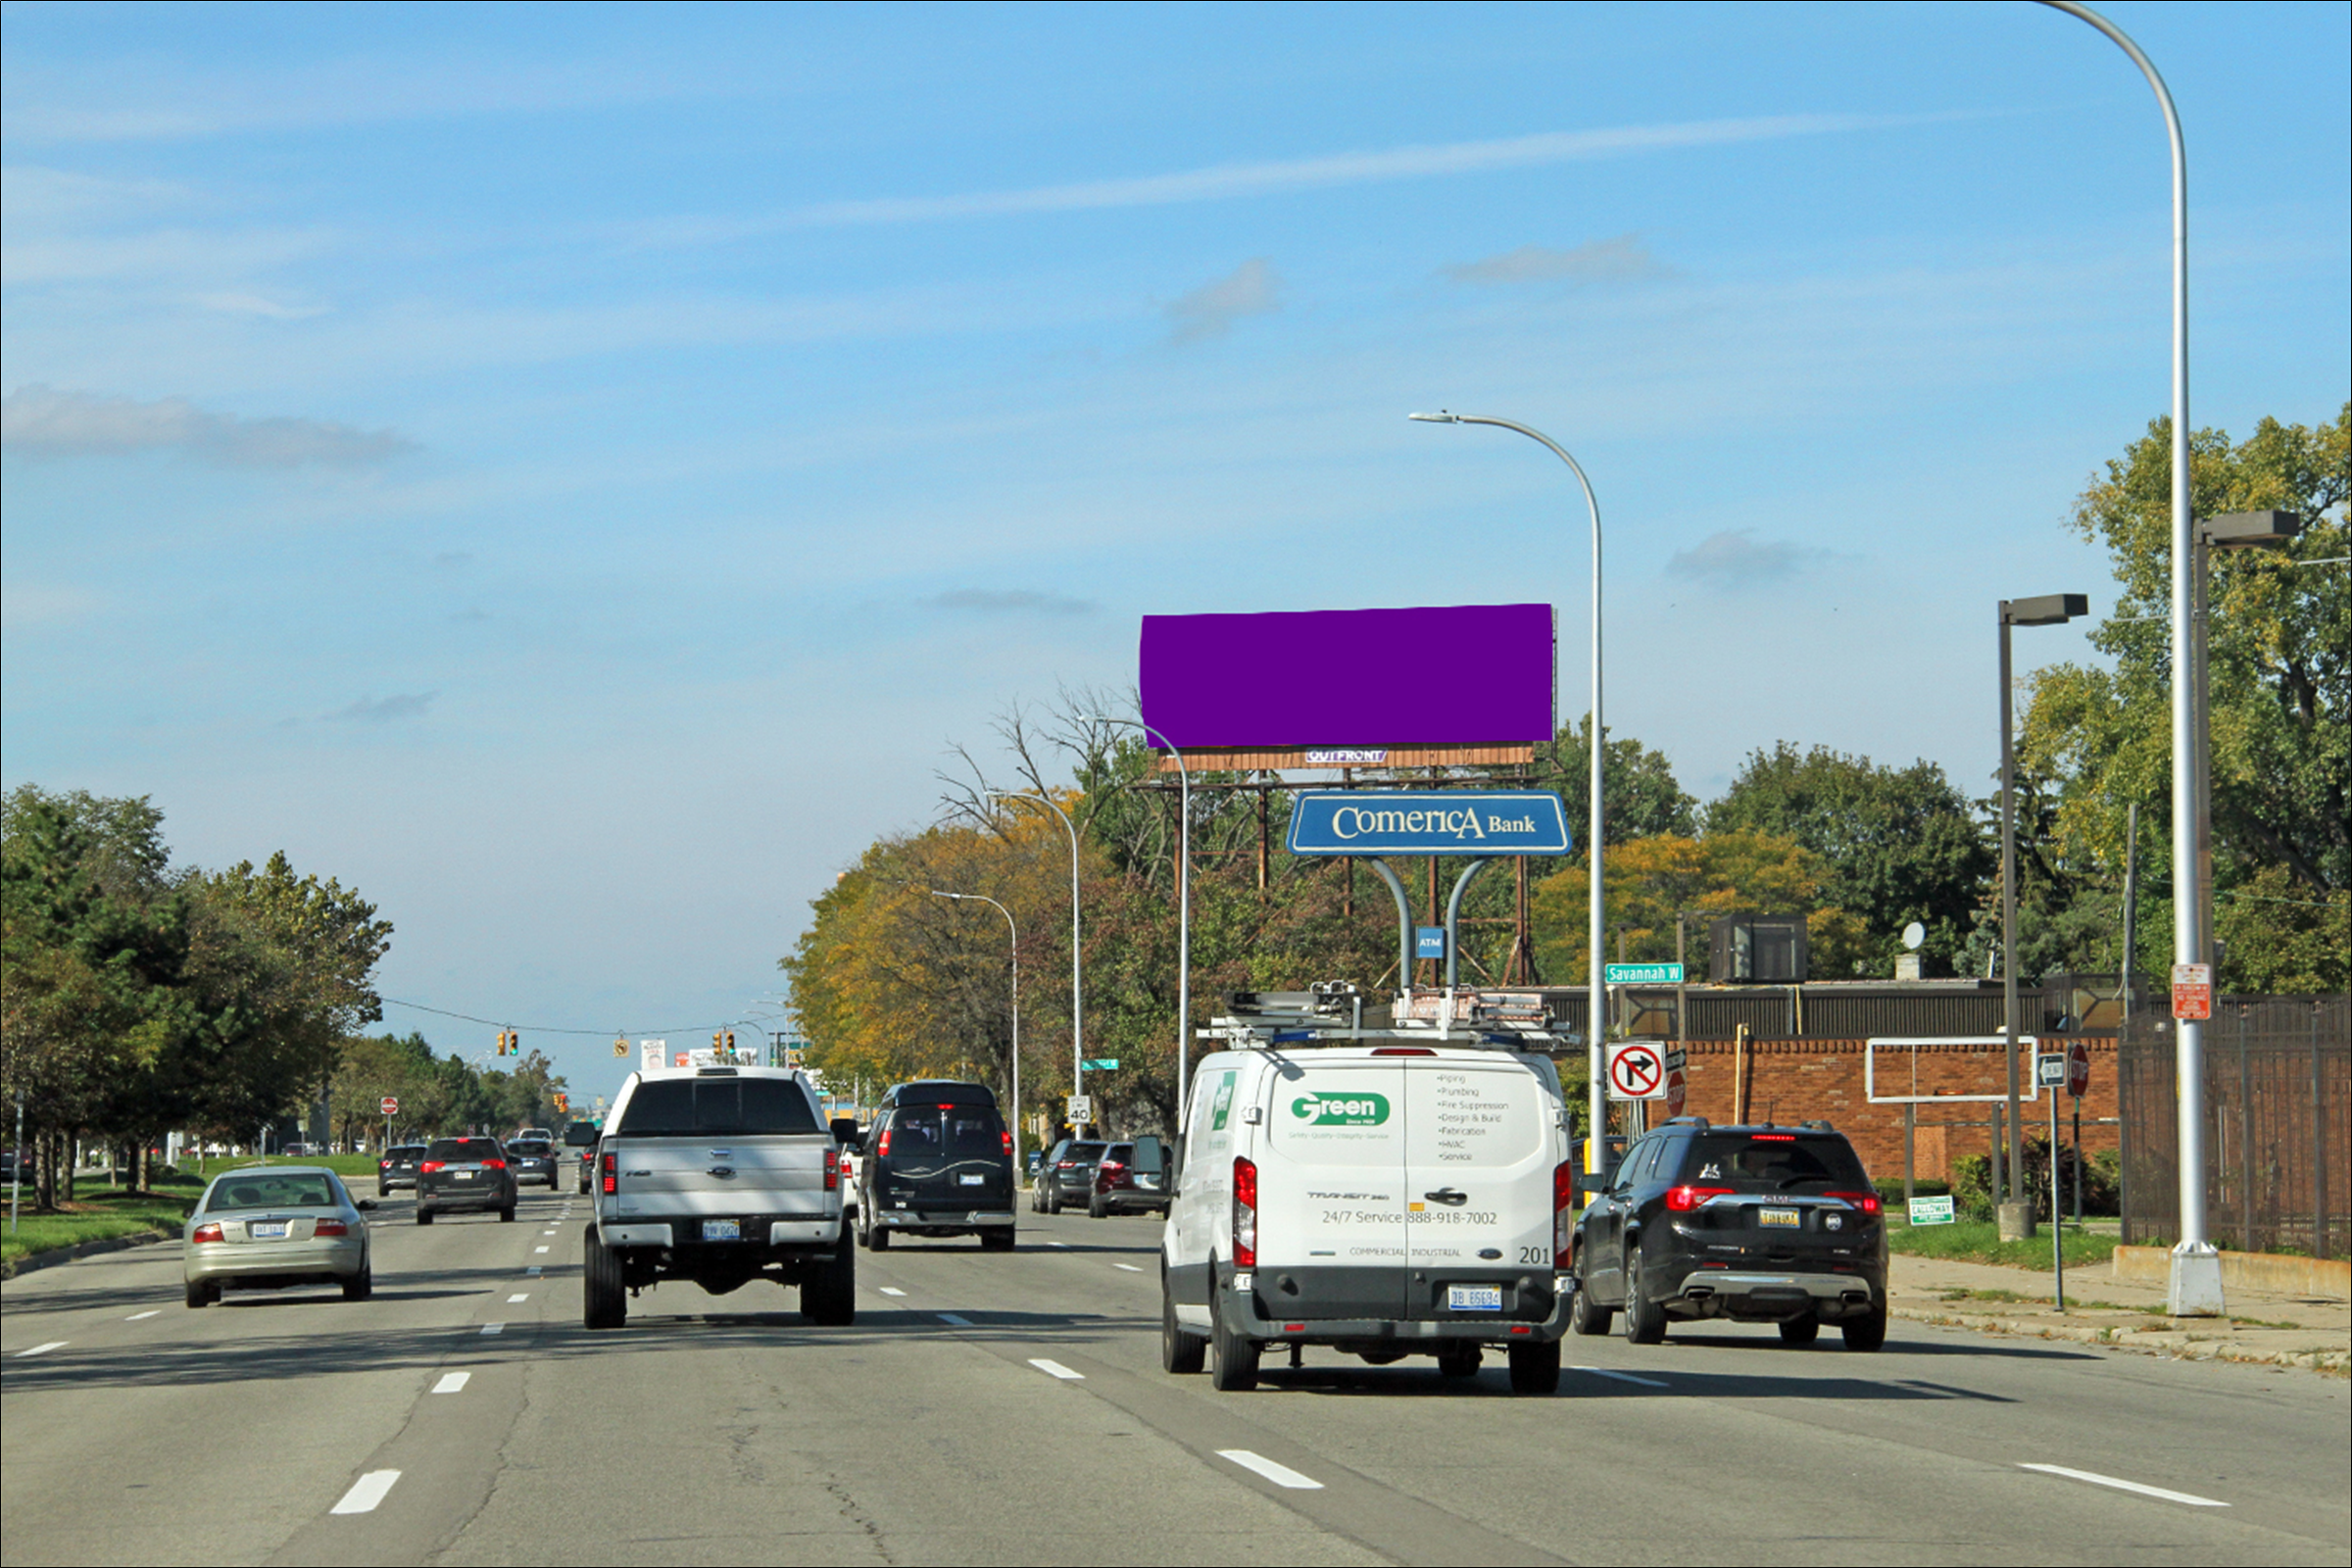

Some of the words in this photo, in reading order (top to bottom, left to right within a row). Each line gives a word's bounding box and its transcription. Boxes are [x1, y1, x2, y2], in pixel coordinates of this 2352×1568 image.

[1308, 750, 1384, 761] OUTFRONT
[1488, 815, 1537, 833] Bank
[1419, 938, 1442, 947] ATM
[1609, 967, 1666, 981] Savannah
[1669, 966, 1680, 980] W
[2071, 1059, 2088, 1081] STOP
[1440, 1074, 1466, 1085] Piping
[1441, 1087, 1480, 1098] Plumbing
[1668, 1084, 1686, 1106] STOP
[1291, 1091, 1376, 1126] Green
[1442, 1101, 1457, 1109] Fire
[1459, 1101, 1509, 1110] Suppression
[1070, 1109, 1088, 1120] 40
[1442, 1113, 1470, 1124] Design
[1481, 1113, 1502, 1122] Build
[1442, 1126, 1486, 1136] Fabrication
[1442, 1140, 1466, 1149] HVAC
[1443, 1152, 1473, 1161] Service
[1307, 1191, 1370, 1200] TRANSIT
[1912, 1203, 1950, 1215] CALLOWAY
[1322, 1210, 1352, 1225] 24/7
[1355, 1210, 1403, 1224] Service
[1406, 1212, 1497, 1225] 888-918-7002
[1348, 1247, 1405, 1256] COMMERCIAL
[1411, 1249, 1461, 1257] INDUSTRIAL
[1519, 1247, 1550, 1264] 201
